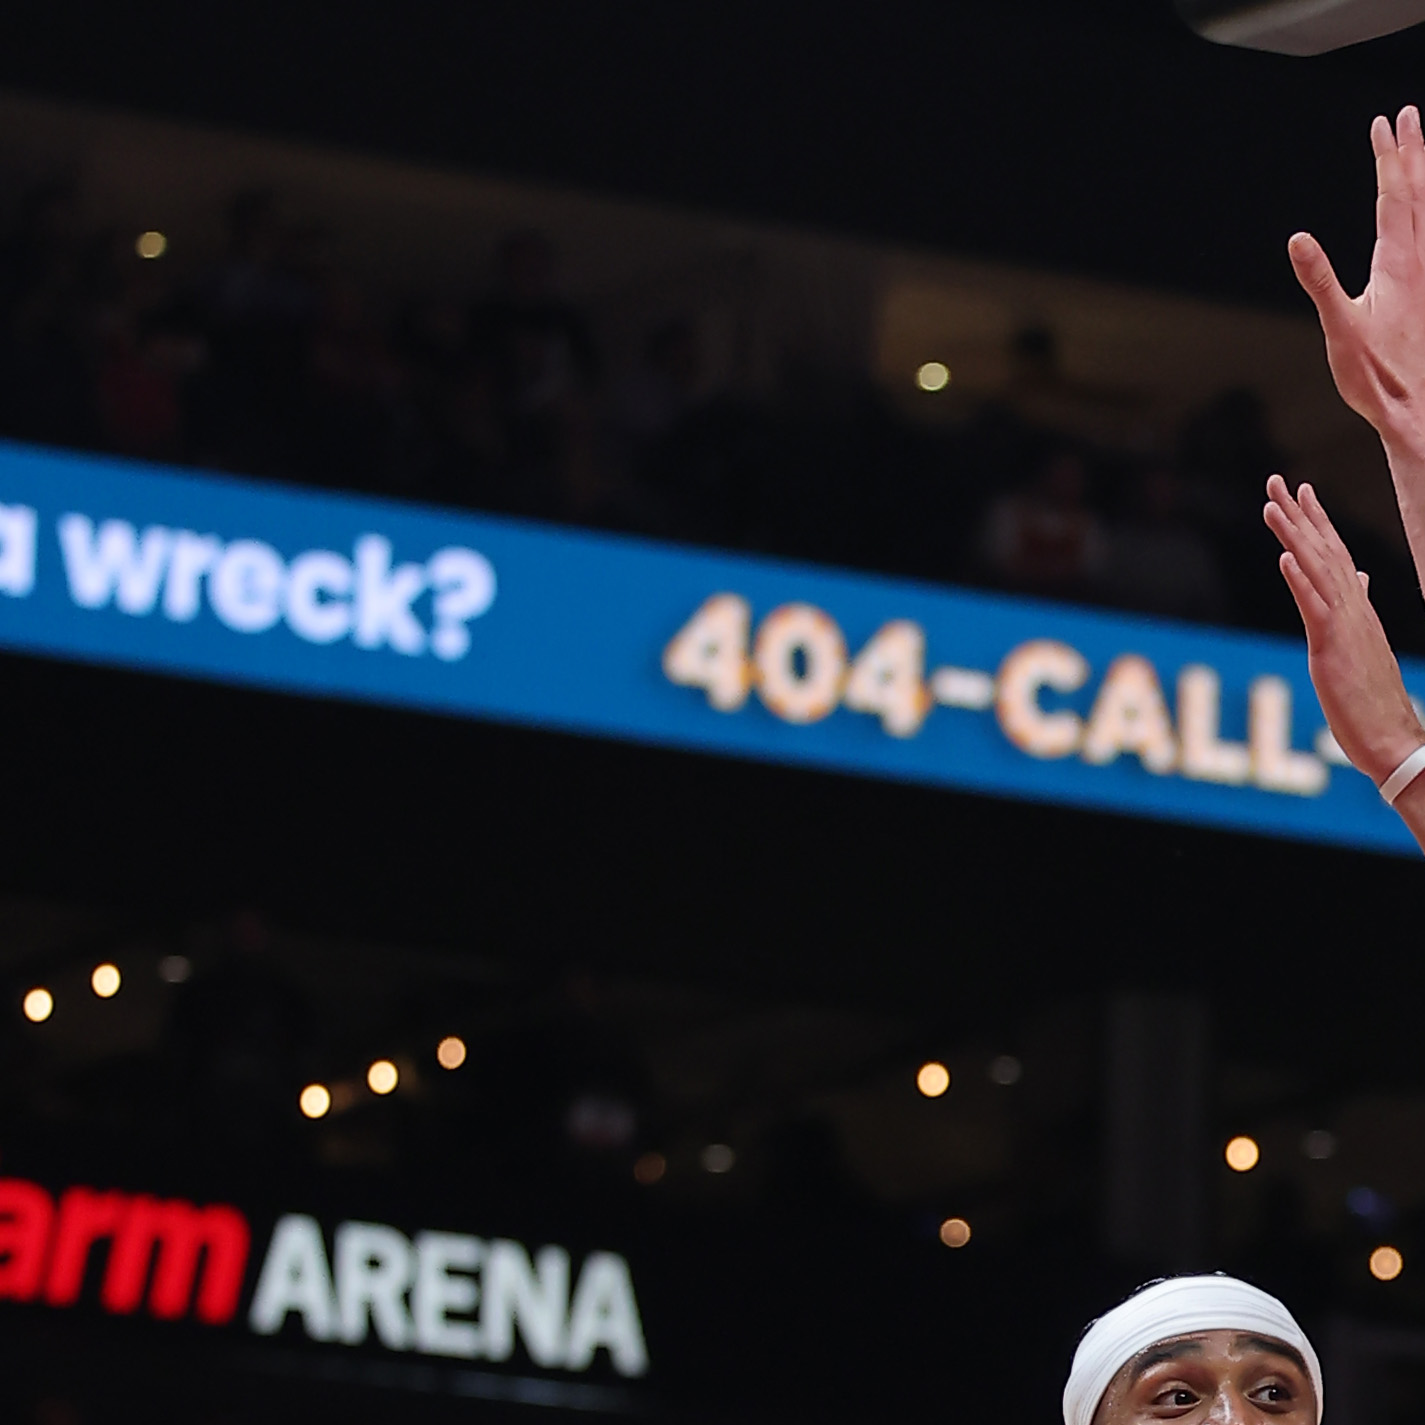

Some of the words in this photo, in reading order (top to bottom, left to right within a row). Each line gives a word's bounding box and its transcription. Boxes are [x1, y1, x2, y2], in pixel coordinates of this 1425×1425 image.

[57, 511, 498, 662] wreck?
[0, 1177, 252, 1326] arm
[248, 1212, 649, 1378] ARENA
